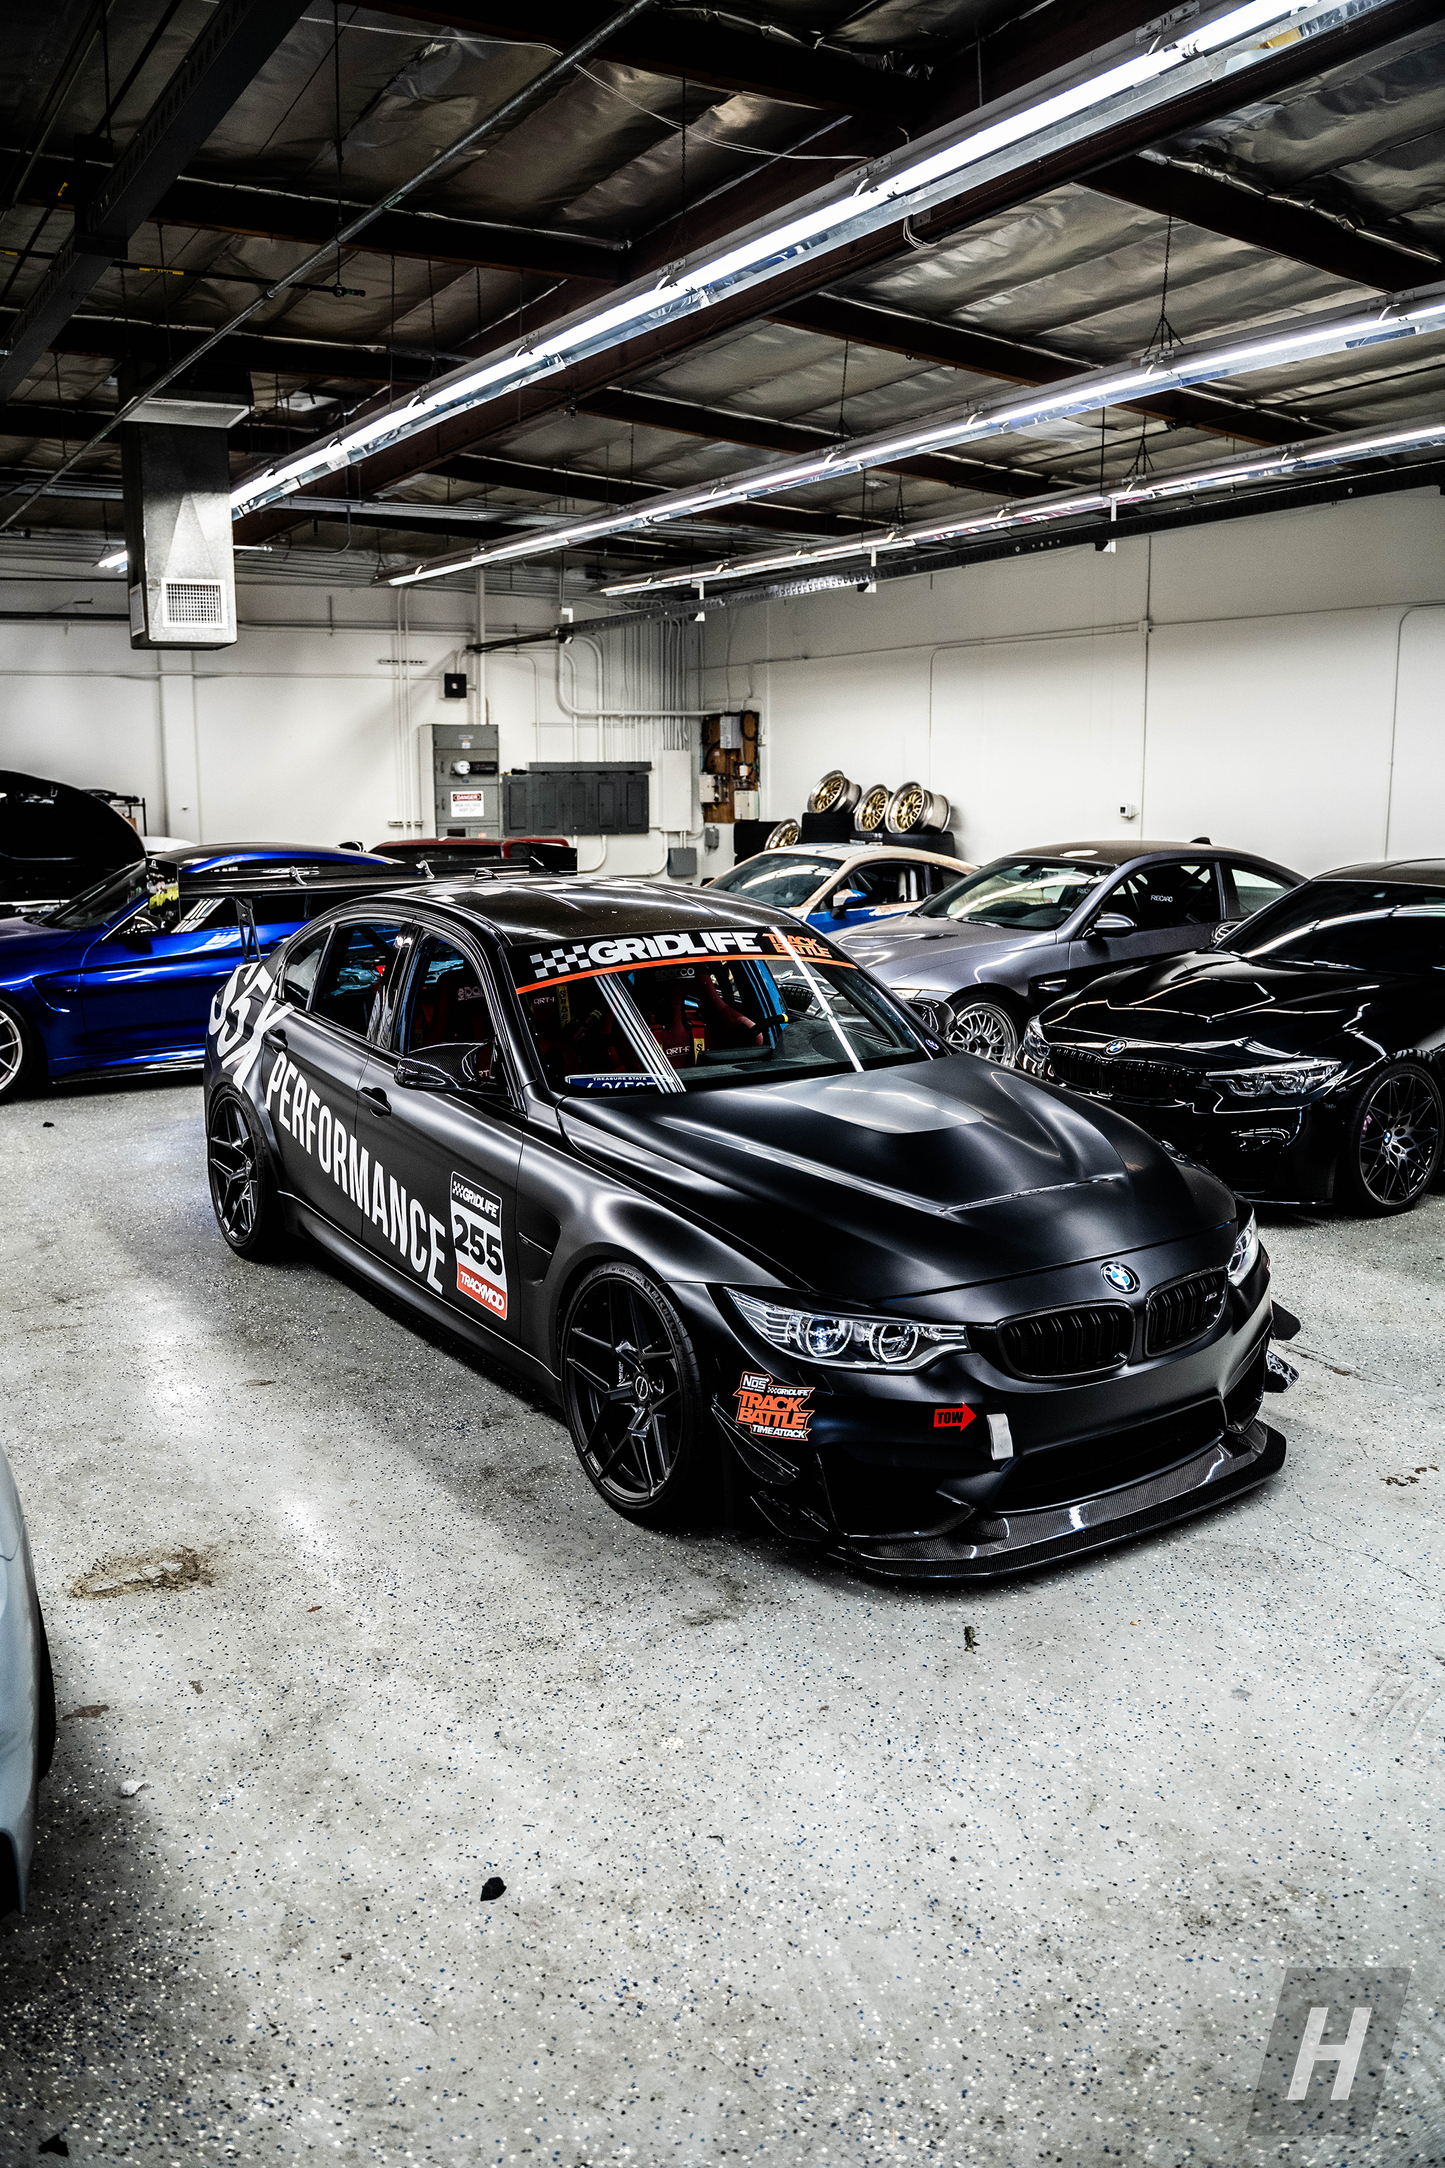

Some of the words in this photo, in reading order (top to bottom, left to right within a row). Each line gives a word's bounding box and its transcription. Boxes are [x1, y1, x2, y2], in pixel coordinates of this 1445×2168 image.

[1150, 894, 1173, 902] RECARO
[588, 932, 763, 965] GRIDLIFE
[264, 1051, 446, 1296] PERFORMANCE
[462, 1187, 499, 1219] GRIDLIFE
[454, 1214, 503, 1276] 255
[460, 1271, 505, 1311] TRACKMOD
[651, 1290, 681, 1342] MICHELIN
[742, 1374, 769, 1390] NOS
[777, 1388, 811, 1396] GRIDLIFE
[737, 1390, 805, 1412] TRACK
[738, 1407, 809, 1430] BATTLE
[937, 1411, 964, 1424] TOW
[752, 1424, 774, 1434] TIME
[772, 1427, 806, 1438] ATTACK
